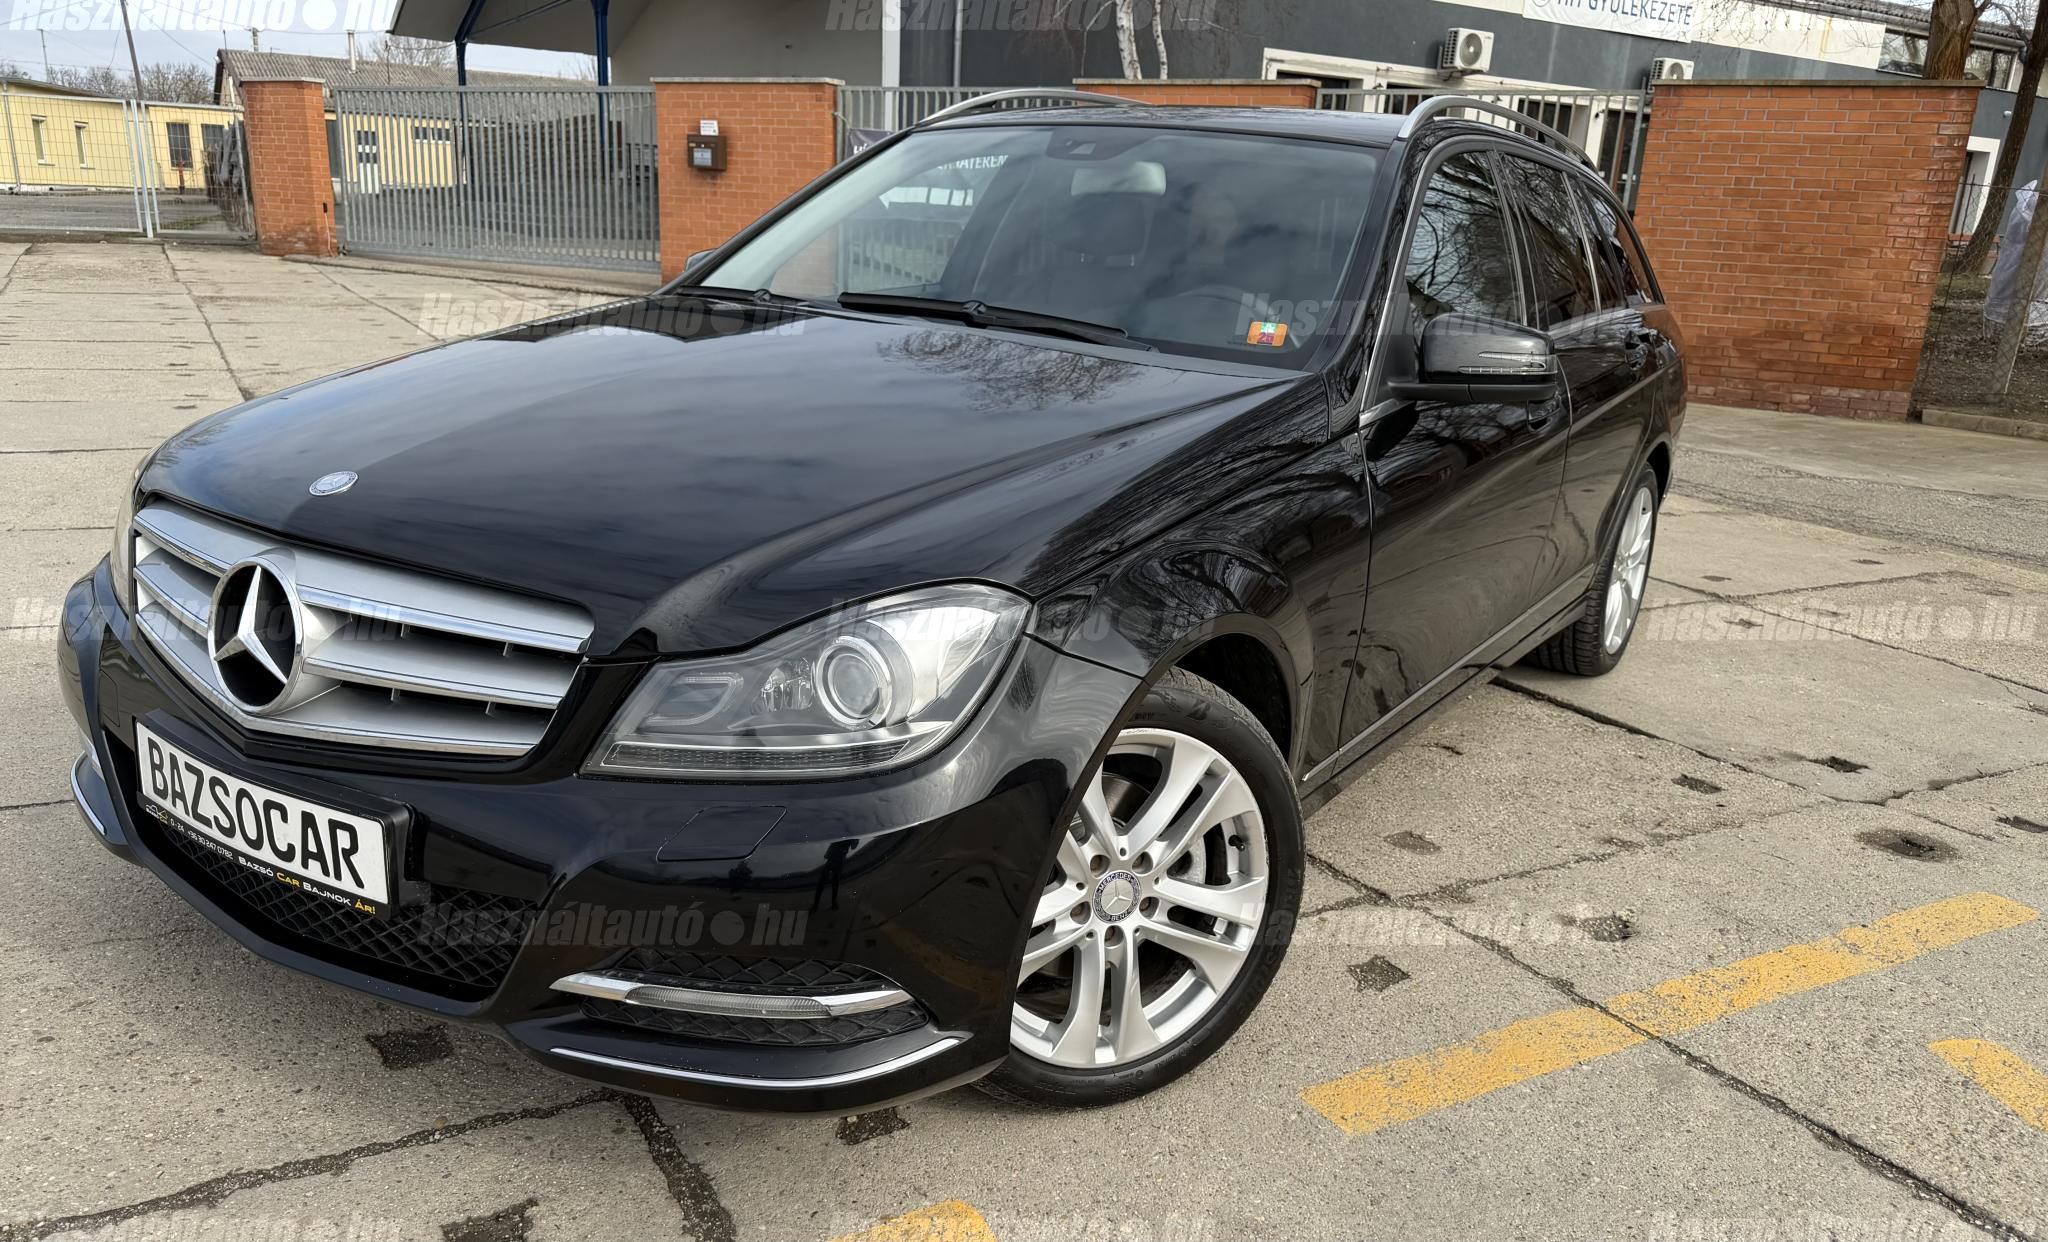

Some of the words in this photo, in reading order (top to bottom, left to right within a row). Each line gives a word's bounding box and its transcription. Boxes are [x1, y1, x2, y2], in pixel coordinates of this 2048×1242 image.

[148, 736, 364, 889] BAZSOCAR
[238, 856, 274, 877] BAZSÓ
[276, 872, 300, 888] CAR
[303, 881, 351, 906] BAJNOK
[354, 899, 376, 914] ÁR!
